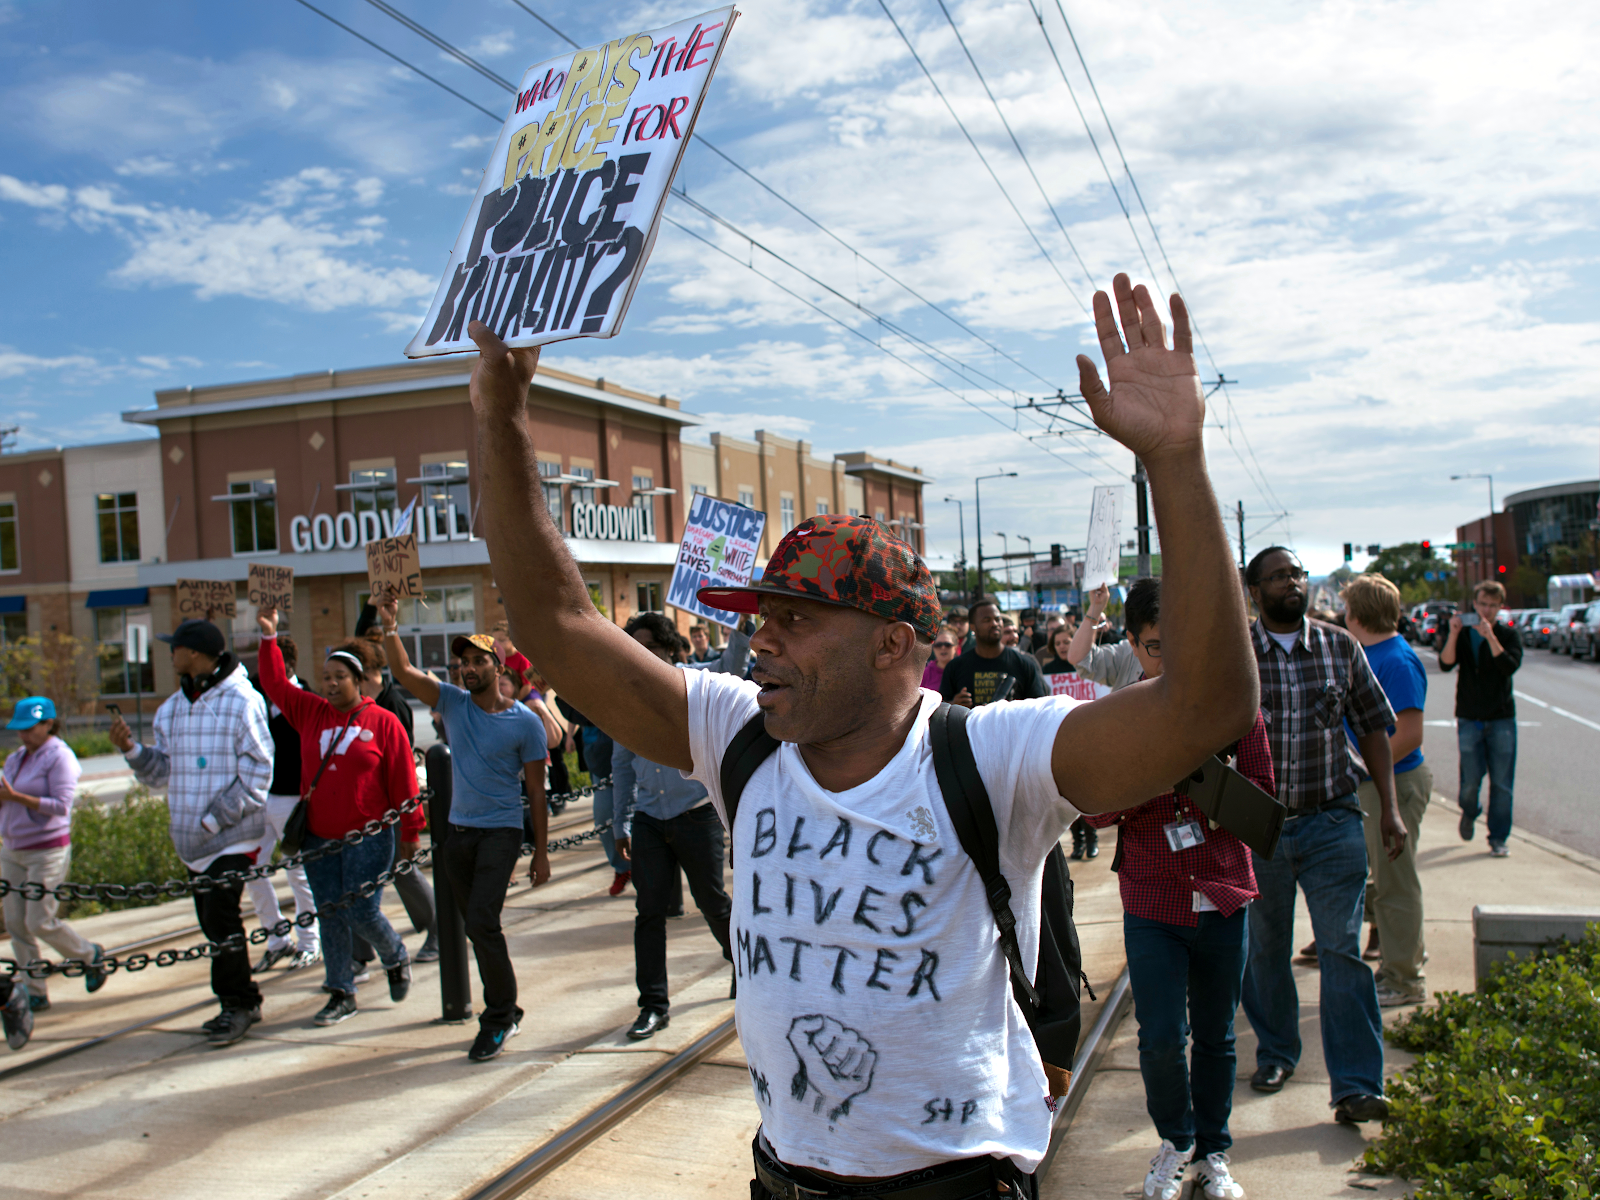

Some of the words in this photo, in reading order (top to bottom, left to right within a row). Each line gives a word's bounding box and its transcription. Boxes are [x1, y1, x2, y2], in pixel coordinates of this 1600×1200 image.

[515, 68, 568, 115] WHO
[553, 32, 653, 119] PAYS
[649, 22, 724, 81] THE
[501, 98, 631, 195] PRICE
[622, 96, 690, 146] FOR
[462, 152, 651, 273] POLICE
[290, 503, 469, 553] GOODWILL
[572, 501, 657, 542] GOODWILL
[689, 497, 764, 543] JUSTICE
[368, 534, 415, 559] AUTISM
[682, 541, 706, 558] BLACK
[725, 546, 752, 572] WHITE
[250, 566, 291, 583] AUTISM
[383, 553, 409, 574] NOT
[680, 552, 710, 574] LIVES
[179, 580, 233, 595] AUTISM
[250, 589, 291, 609] CRIME
[974, 671, 998, 679] BLACK
[974, 687, 996, 695] MATT
[751, 807, 943, 885] BLACK
[752, 870, 927, 937] LIVES
[736, 924, 942, 1002] MATTER
